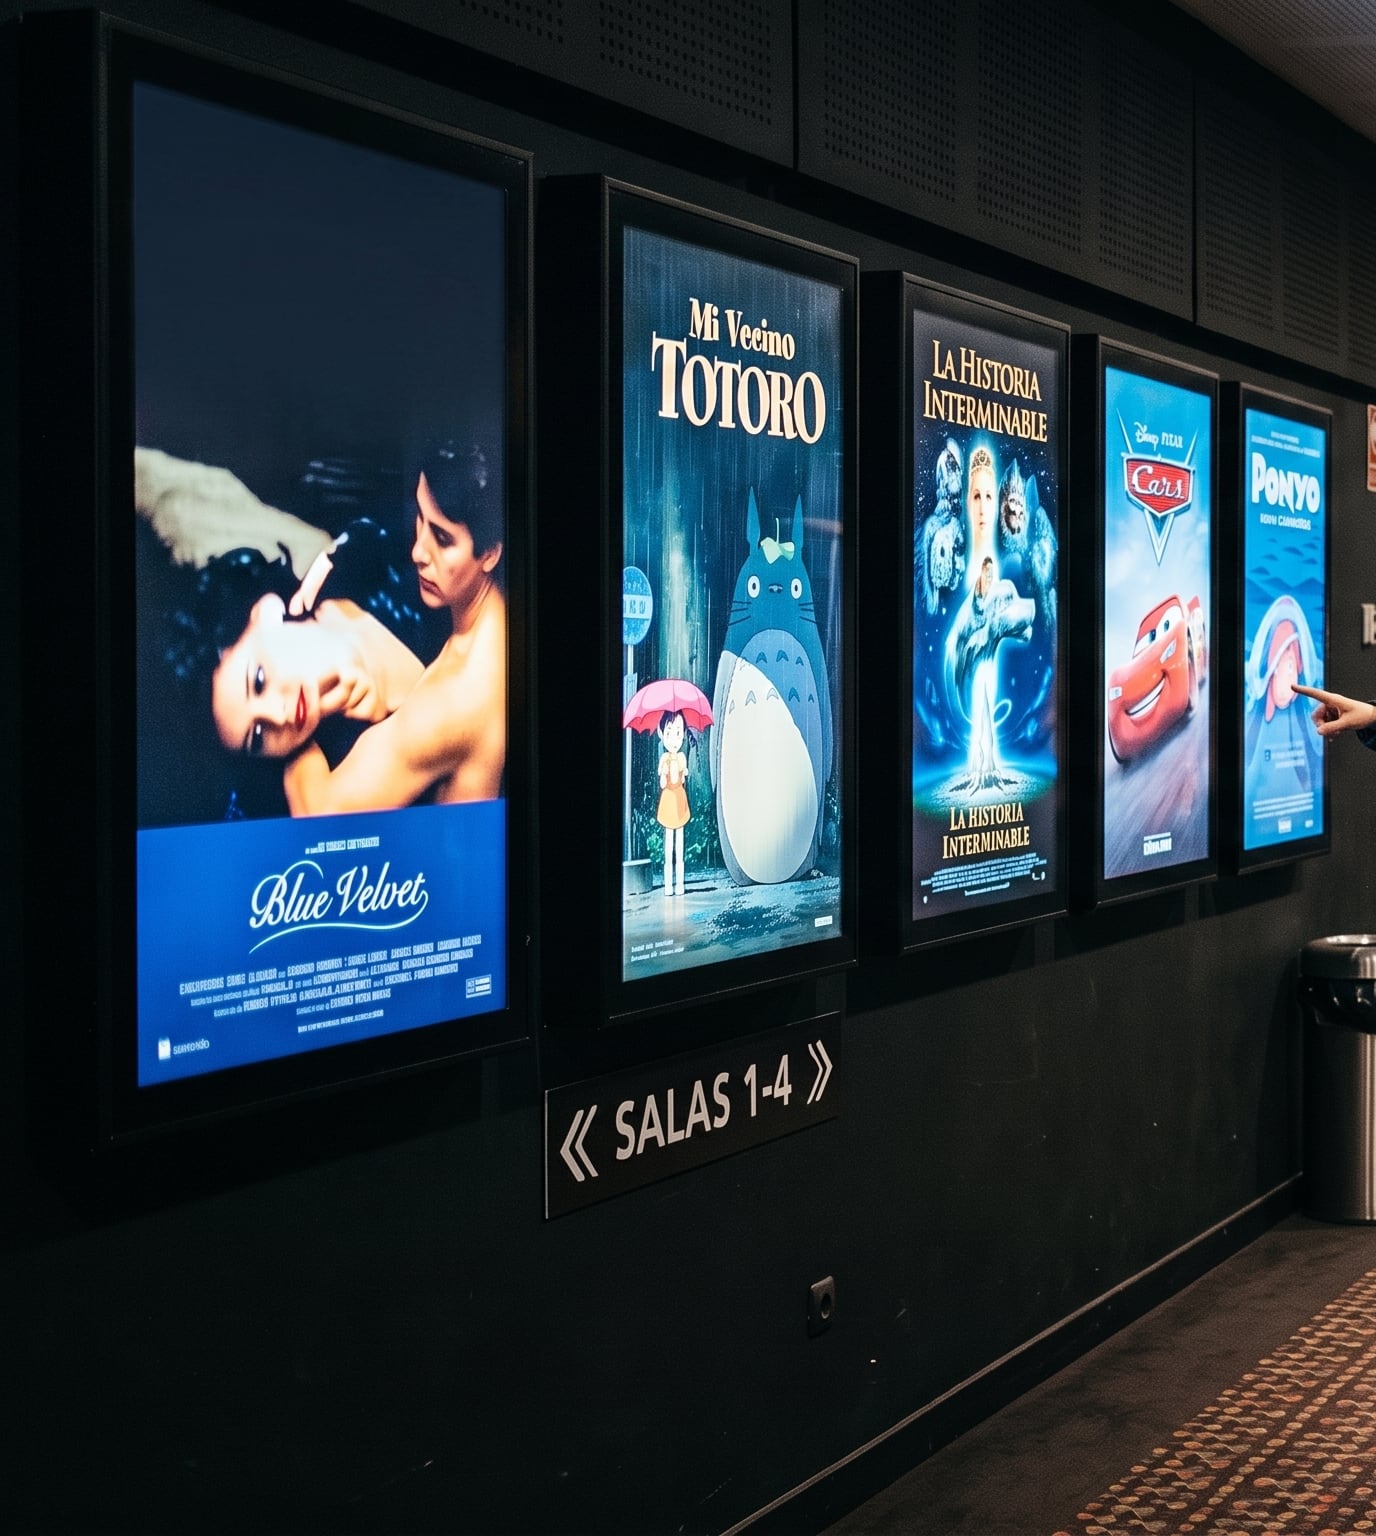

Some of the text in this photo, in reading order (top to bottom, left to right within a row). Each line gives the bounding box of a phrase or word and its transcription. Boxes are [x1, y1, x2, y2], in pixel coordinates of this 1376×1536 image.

[689, 297, 796, 361] Mi Vecino
[651, 330, 827, 445] TOTORO
[932, 339, 1043, 402] LA HISTORIA
[922, 379, 1049, 443] INTERMINABLE
[1131, 464, 1186, 500] Cars
[1251, 451, 1321, 514] PONYO
[942, 825, 1031, 860] INTERMINABLE
[949, 801, 1025, 832] LA HISTORIA
[249, 860, 430, 929] Blue Velvet
[615, 1053, 793, 1161] SALAS 1-4
